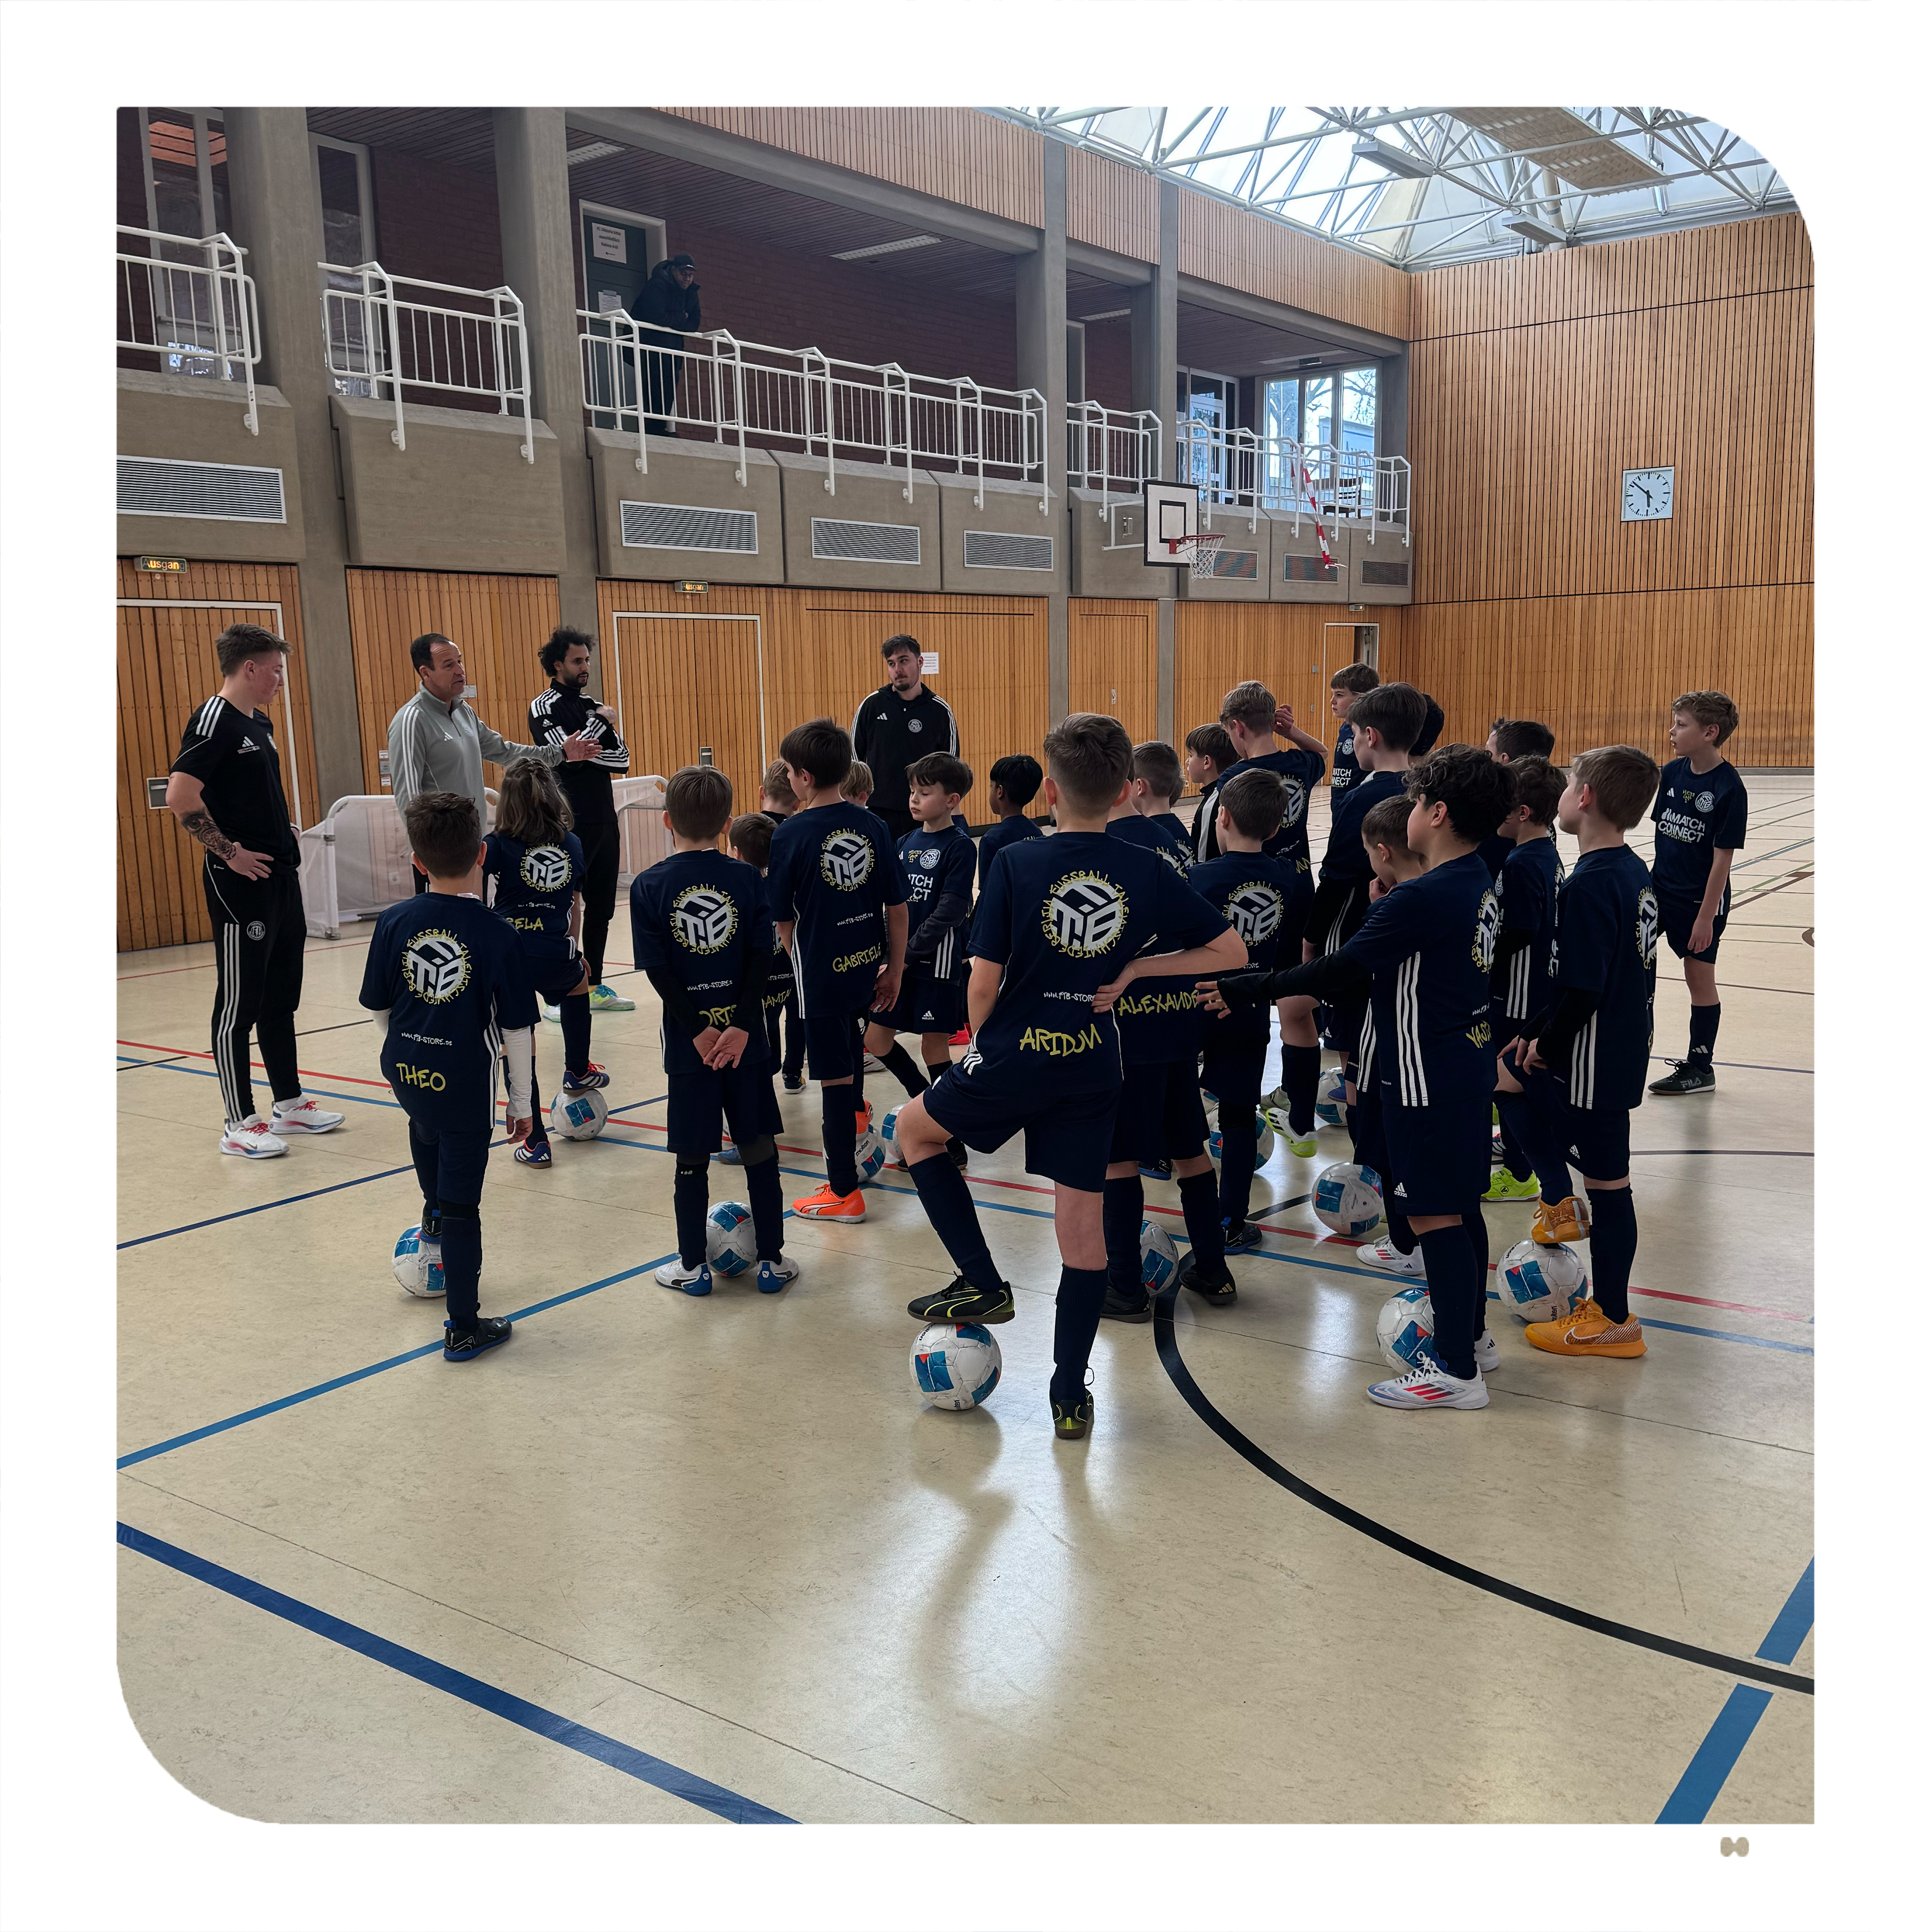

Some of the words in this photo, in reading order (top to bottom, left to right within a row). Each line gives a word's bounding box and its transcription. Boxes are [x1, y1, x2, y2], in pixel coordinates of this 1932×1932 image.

[142, 558, 185, 572] Ausgang
[1658, 821, 1705, 842] CONNECT
[1670, 812, 1705, 832] MATCH
[396, 1063, 446, 1091] THEO
[1680, 1076, 1702, 1089] FILA
